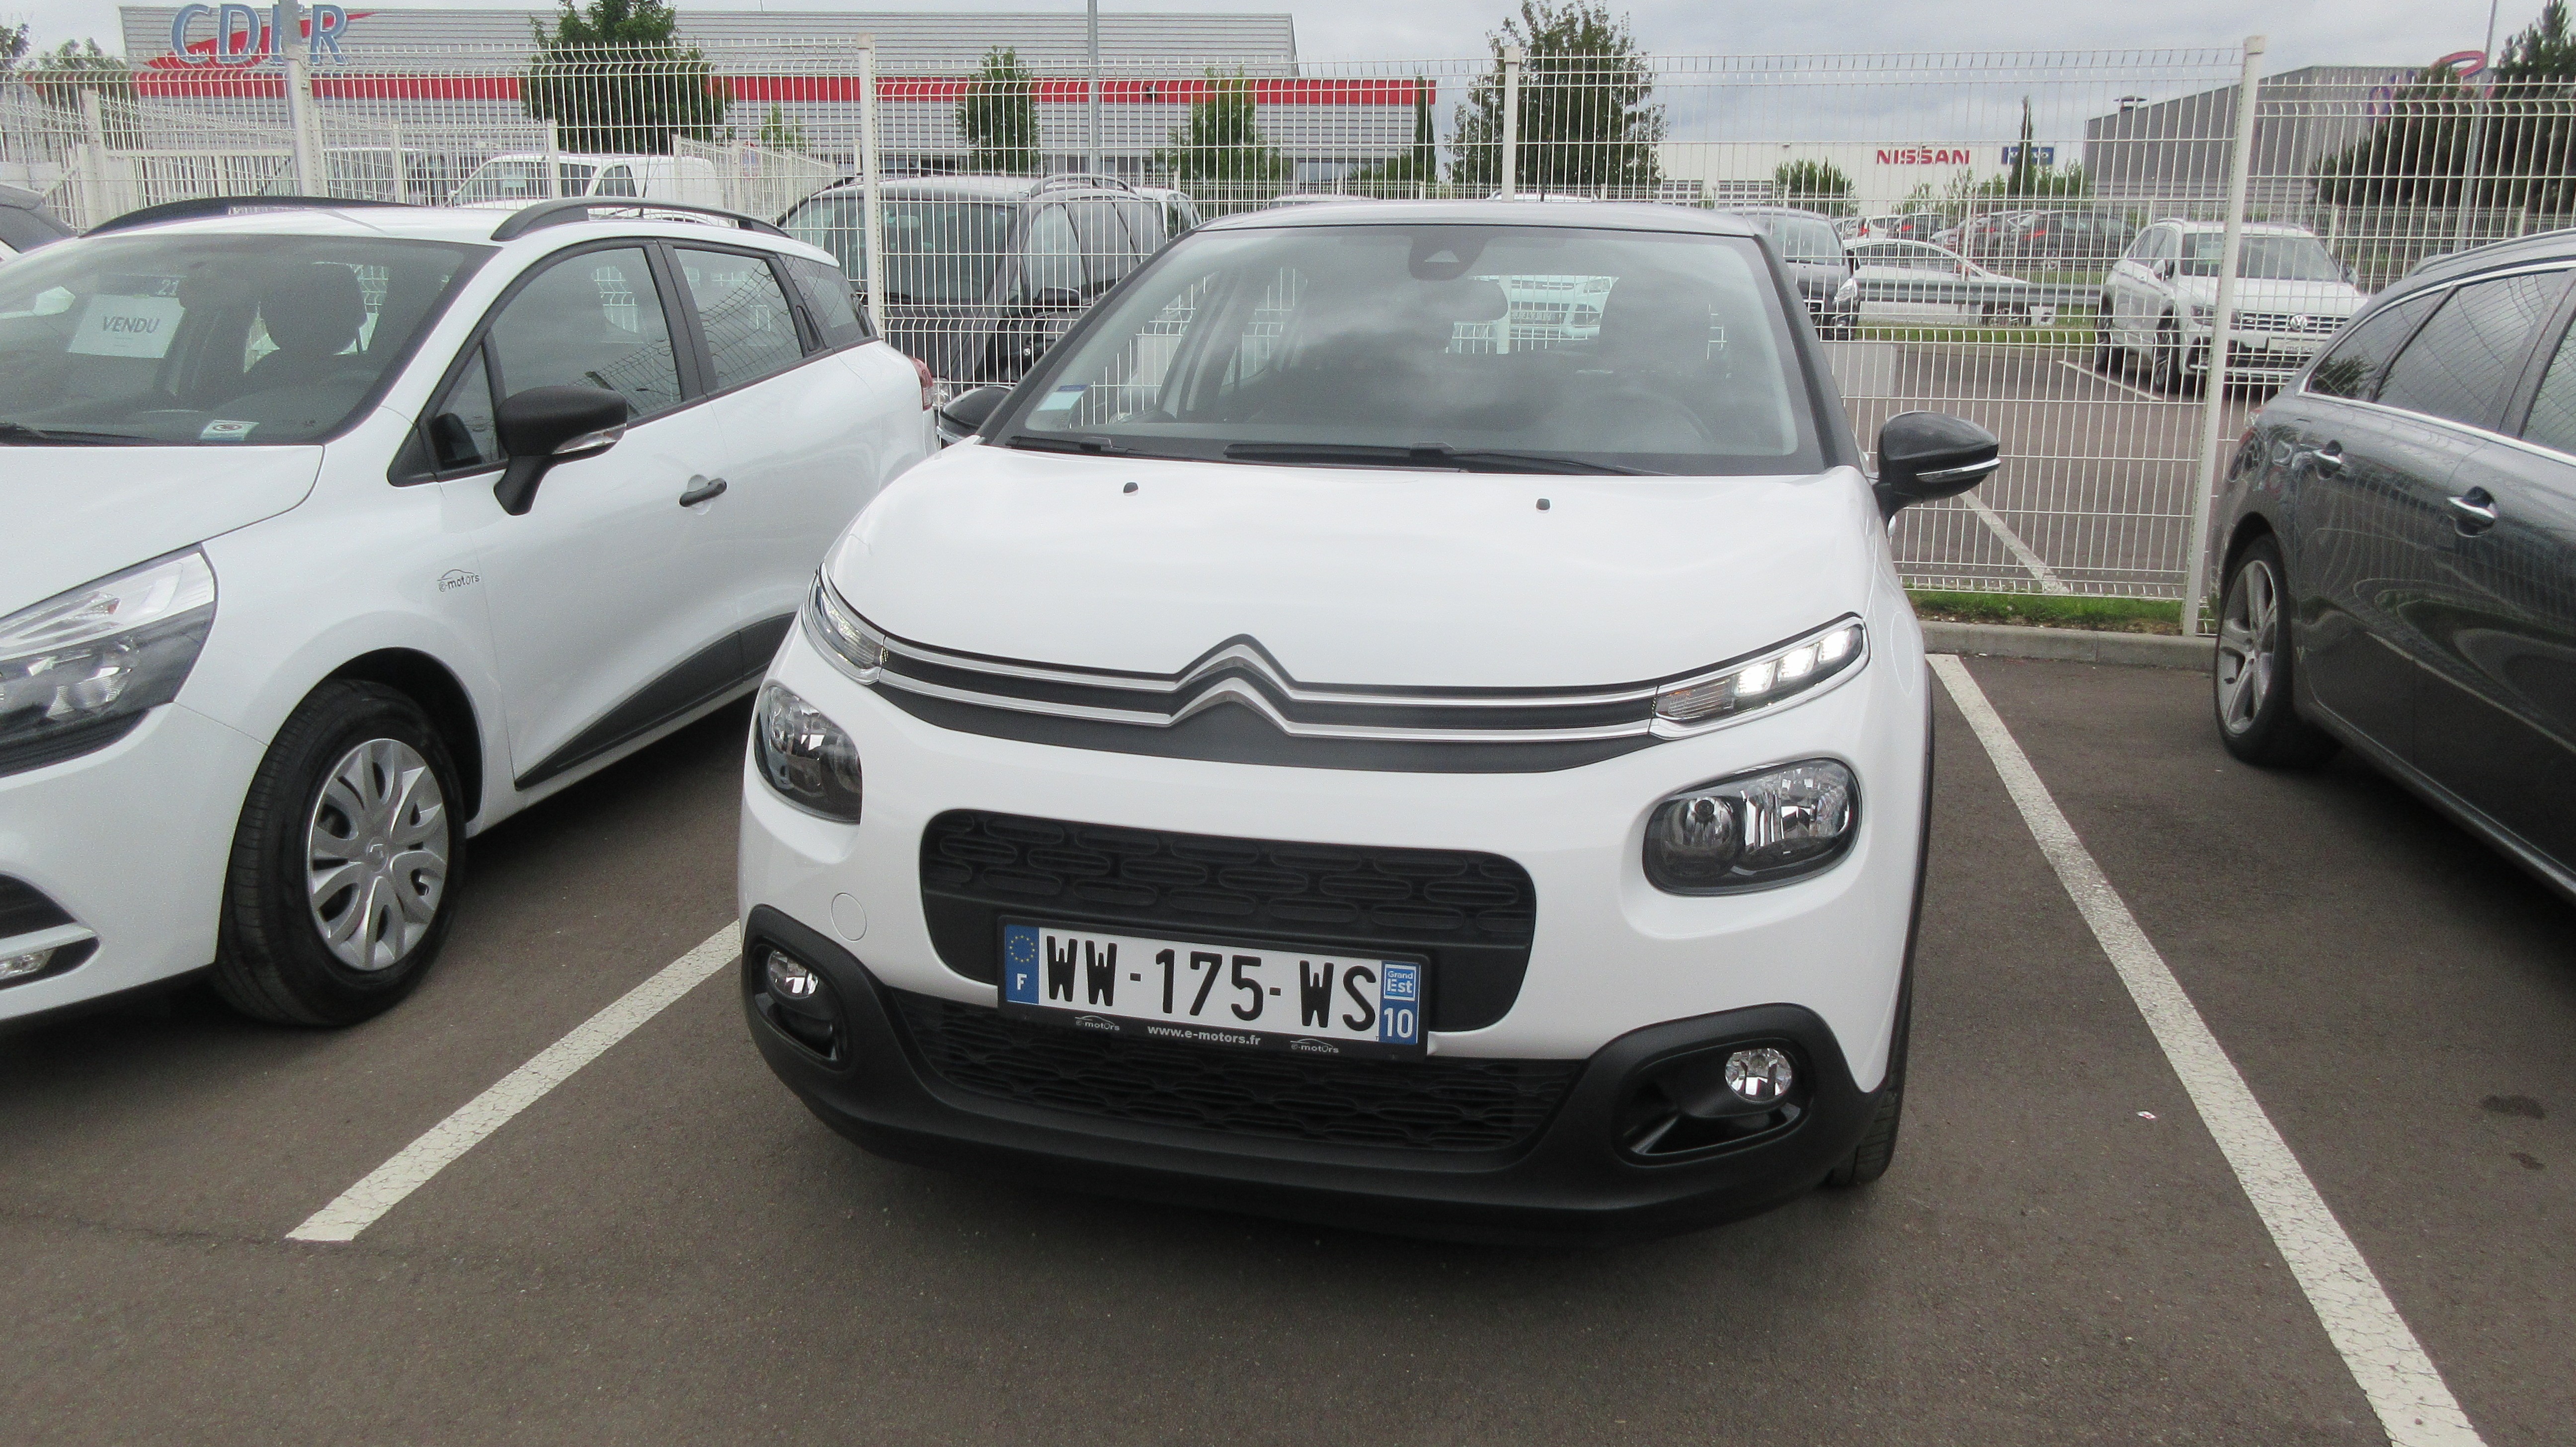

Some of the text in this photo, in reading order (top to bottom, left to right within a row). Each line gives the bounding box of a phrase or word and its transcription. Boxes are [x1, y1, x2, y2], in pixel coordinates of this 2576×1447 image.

[1876, 150, 1971, 164] NISSAN
[102, 316, 161, 333] VENDU
[1017, 973, 1027, 990] F
[1387, 970, 1413, 979] Grand
[1387, 978, 1413, 993] Est
[1384, 1007, 1413, 1038] 10
[1147, 1025, 1261, 1045] www.e-motors.fr
